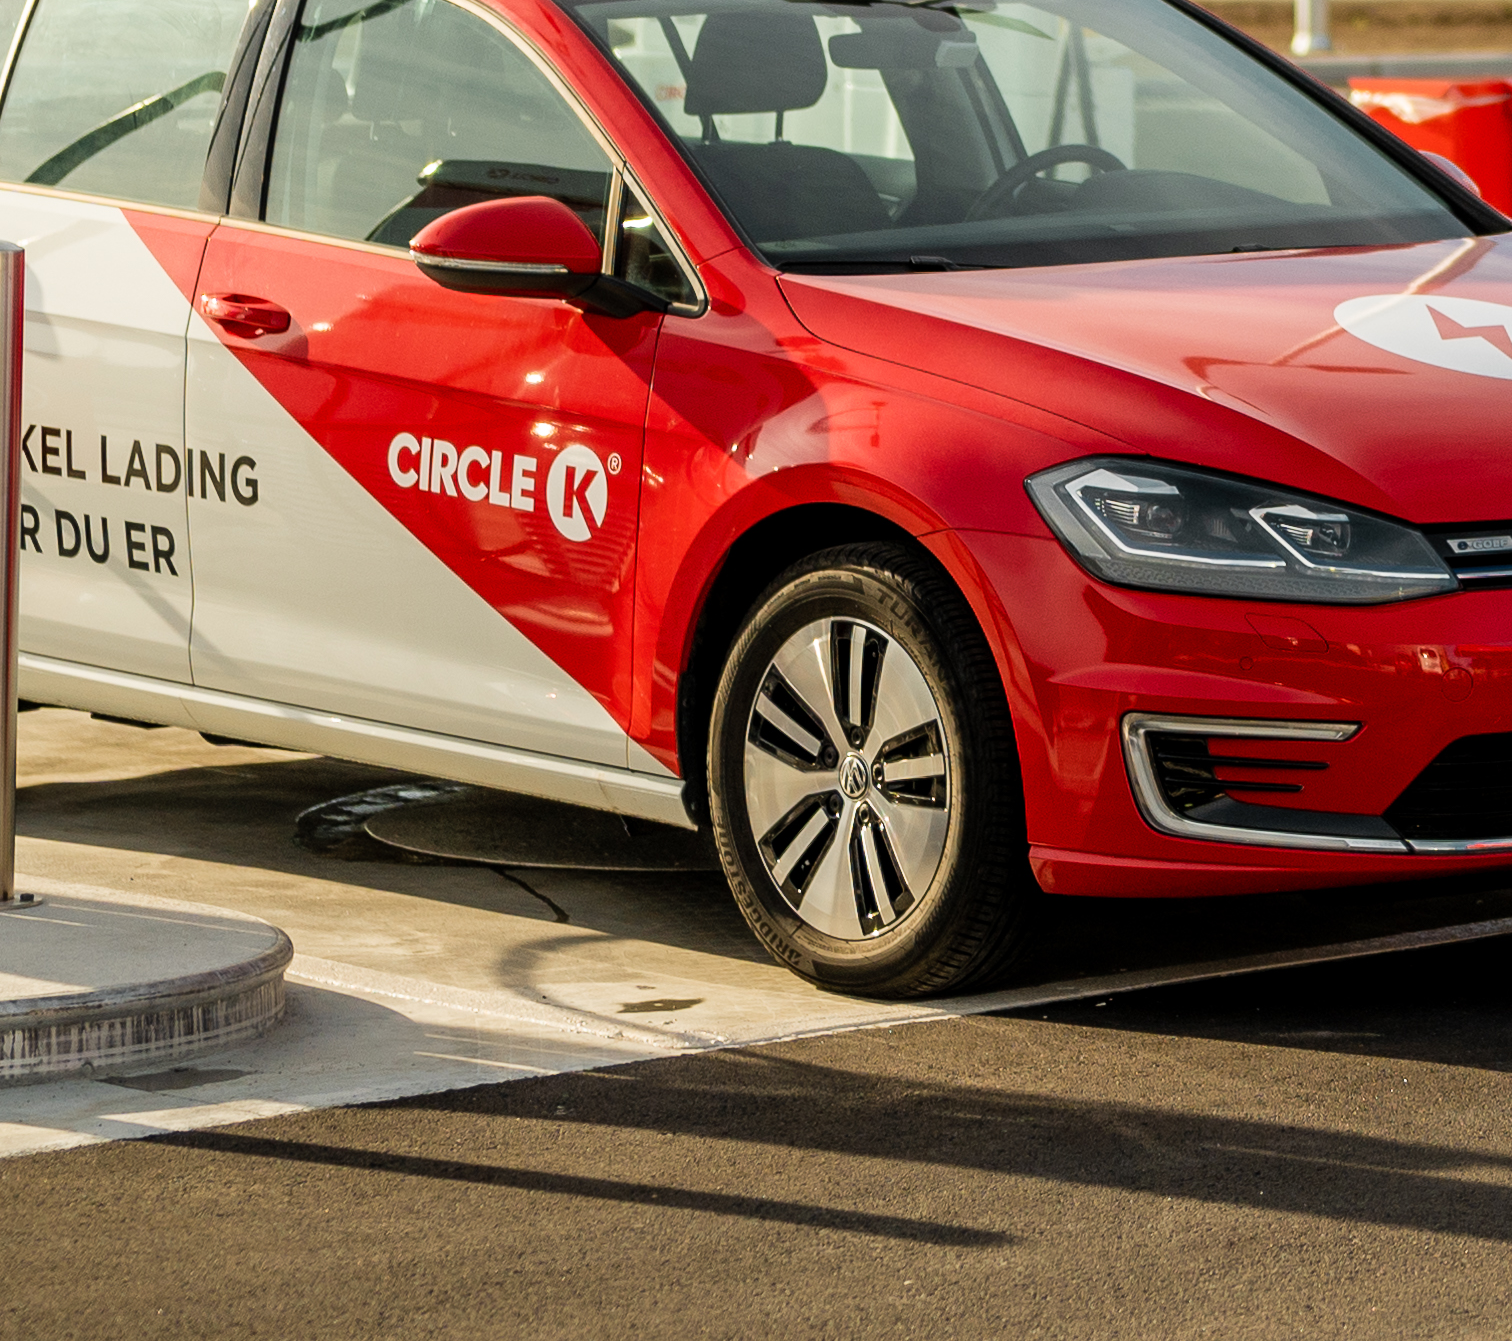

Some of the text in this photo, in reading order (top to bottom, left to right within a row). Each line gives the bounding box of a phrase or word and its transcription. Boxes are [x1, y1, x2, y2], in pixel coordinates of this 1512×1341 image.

[21, 423, 259, 507] KEL LADING
[388, 432, 608, 540] CIRCLE K
[54, 509, 111, 565] DU
[124, 520, 179, 578] ER
